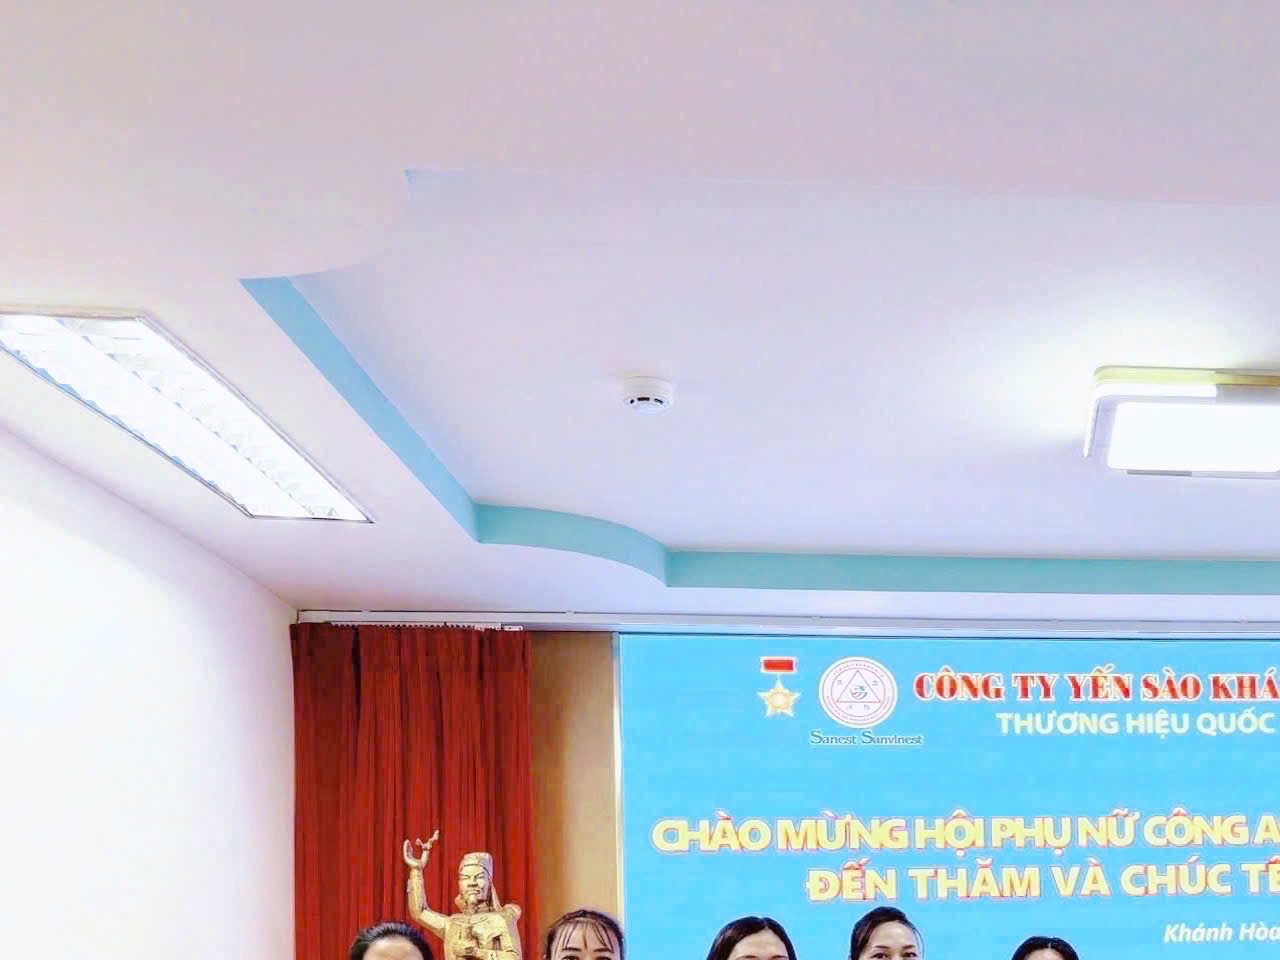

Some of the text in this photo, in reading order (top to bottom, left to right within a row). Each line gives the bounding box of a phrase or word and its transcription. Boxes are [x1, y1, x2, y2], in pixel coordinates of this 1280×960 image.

[913, 665, 1005, 702] CÔNG
[1012, 673, 1059, 701] TY
[1063, 664, 1133, 701] YẾN
[1140, 667, 1203, 702] SÀO
[810, 730, 857, 745] Sanest
[996, 710, 1119, 735] THƯƠNG
[1125, 708, 1190, 740] HIỆU
[1196, 706, 1275, 736] QUỐC
[651, 808, 772, 854] CHÀO
[776, 808, 908, 852] MỪNG
[914, 807, 986, 858] HỘI
[991, 815, 1073, 858] PHỤ
[1077, 807, 1141, 852] NỮ
[1143, 806, 1250, 848] CÔNG
[805, 857, 898, 901] ĐẾN
[907, 857, 1041, 900] THĂM
[1050, 856, 1112, 897] VÀ
[1120, 854, 1232, 897] CHÚC
[1163, 922, 1233, 943] Khánh
